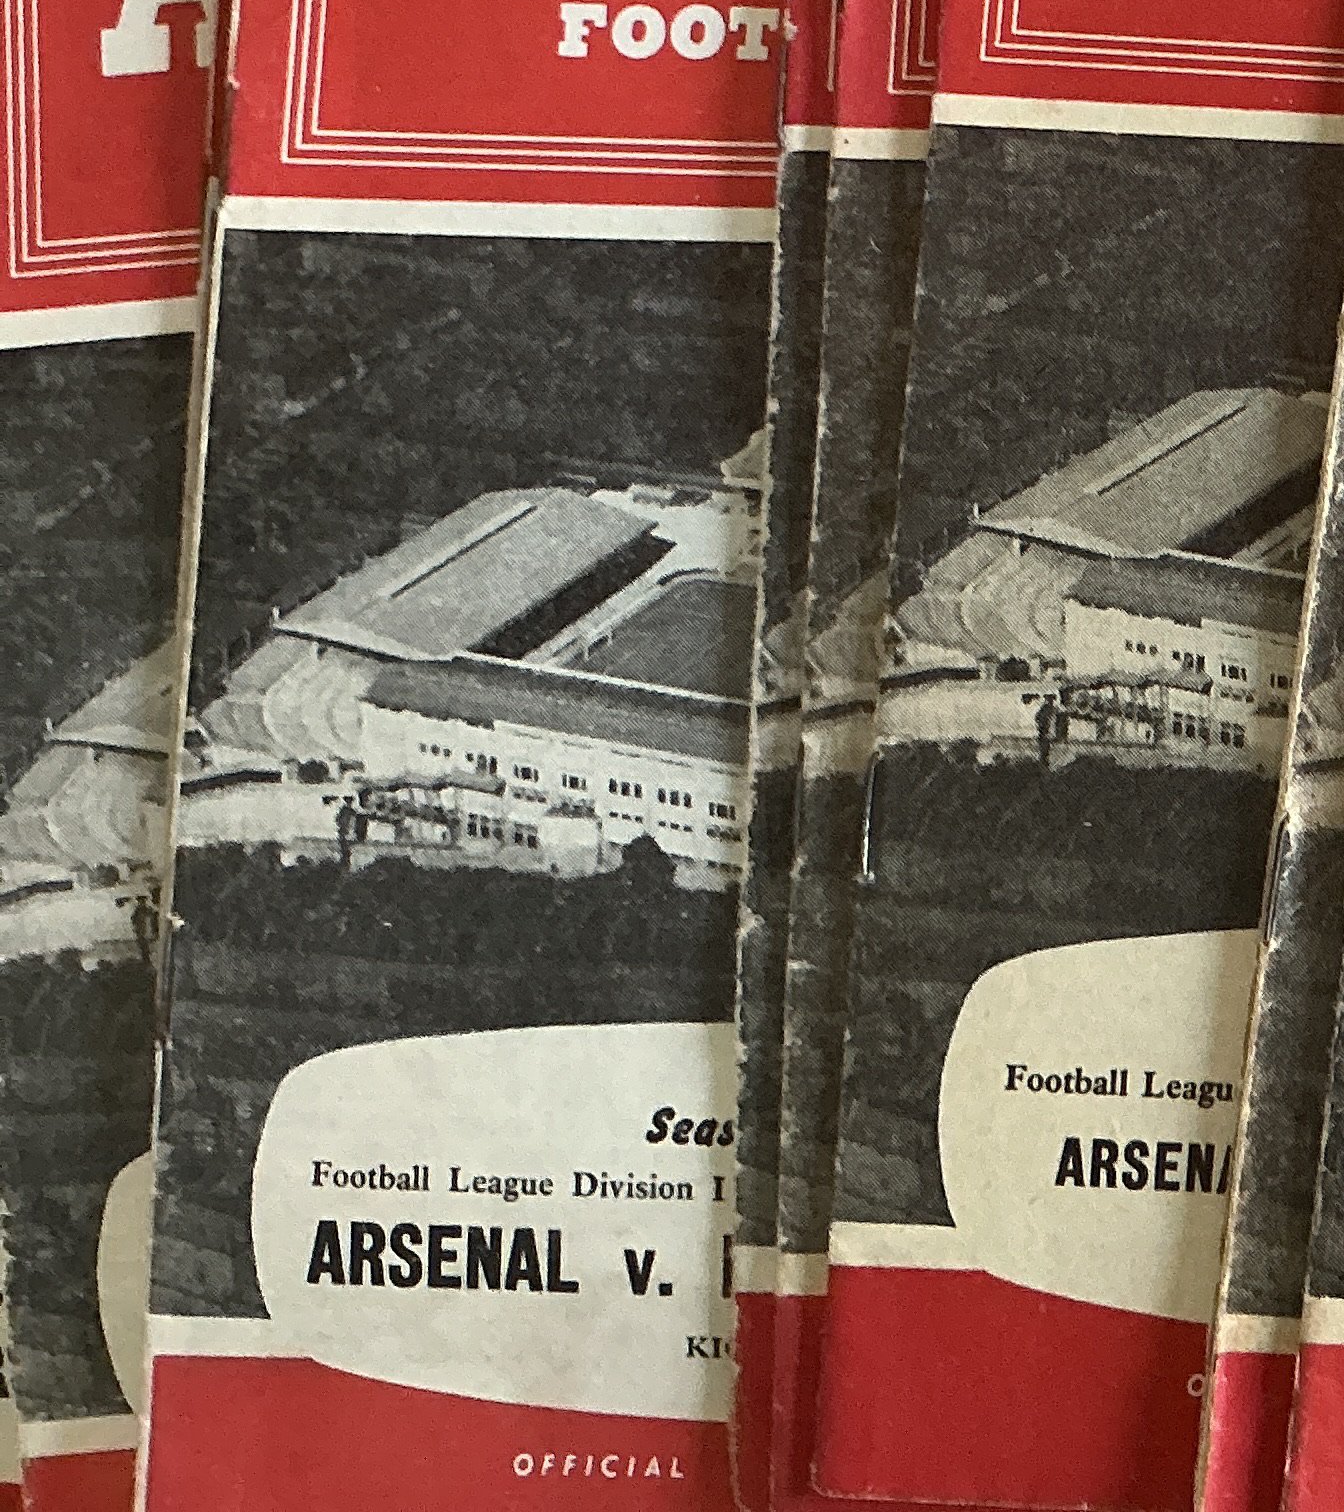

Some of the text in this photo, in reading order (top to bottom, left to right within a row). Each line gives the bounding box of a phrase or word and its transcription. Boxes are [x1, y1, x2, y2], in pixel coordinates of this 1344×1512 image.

[1004, 1063, 1129, 1098] Football
[311, 1160, 725, 1202] Football League Division I
[305, 1219, 580, 1294] ARSENAL
[623, 1248, 674, 1297] v.
[512, 1452, 686, 1480] OFFICIAL
